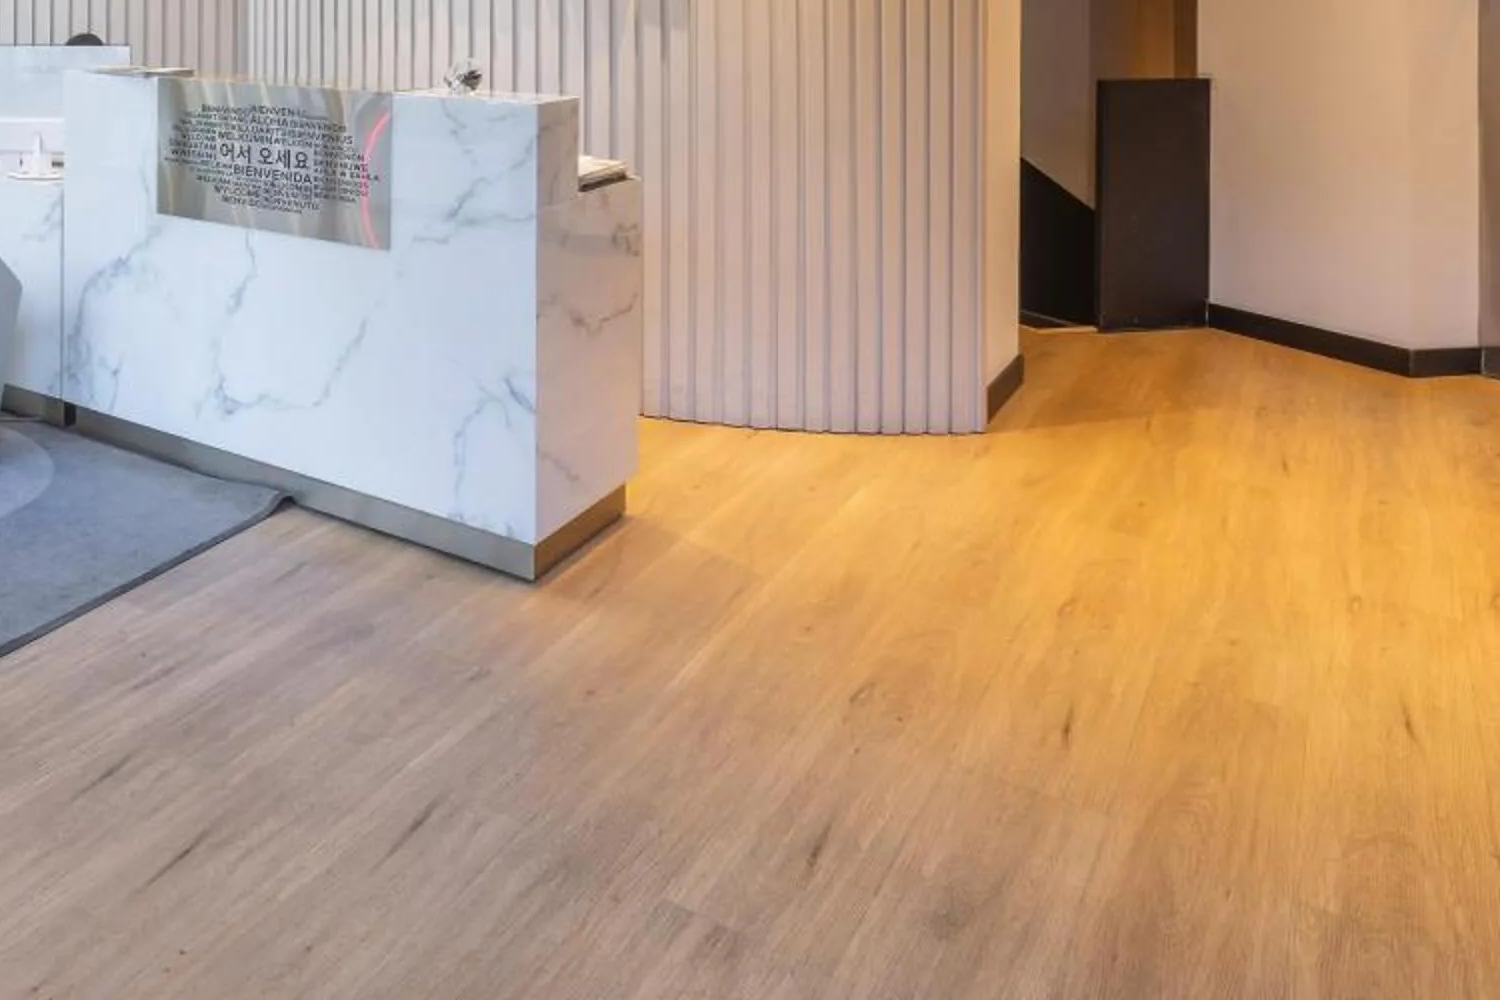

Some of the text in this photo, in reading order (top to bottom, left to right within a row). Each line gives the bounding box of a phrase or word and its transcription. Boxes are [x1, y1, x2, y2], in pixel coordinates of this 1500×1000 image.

[220, 143, 251, 164] 어서
[258, 147, 309, 170] 오세요
[233, 164, 313, 185] BIENVENIDA
